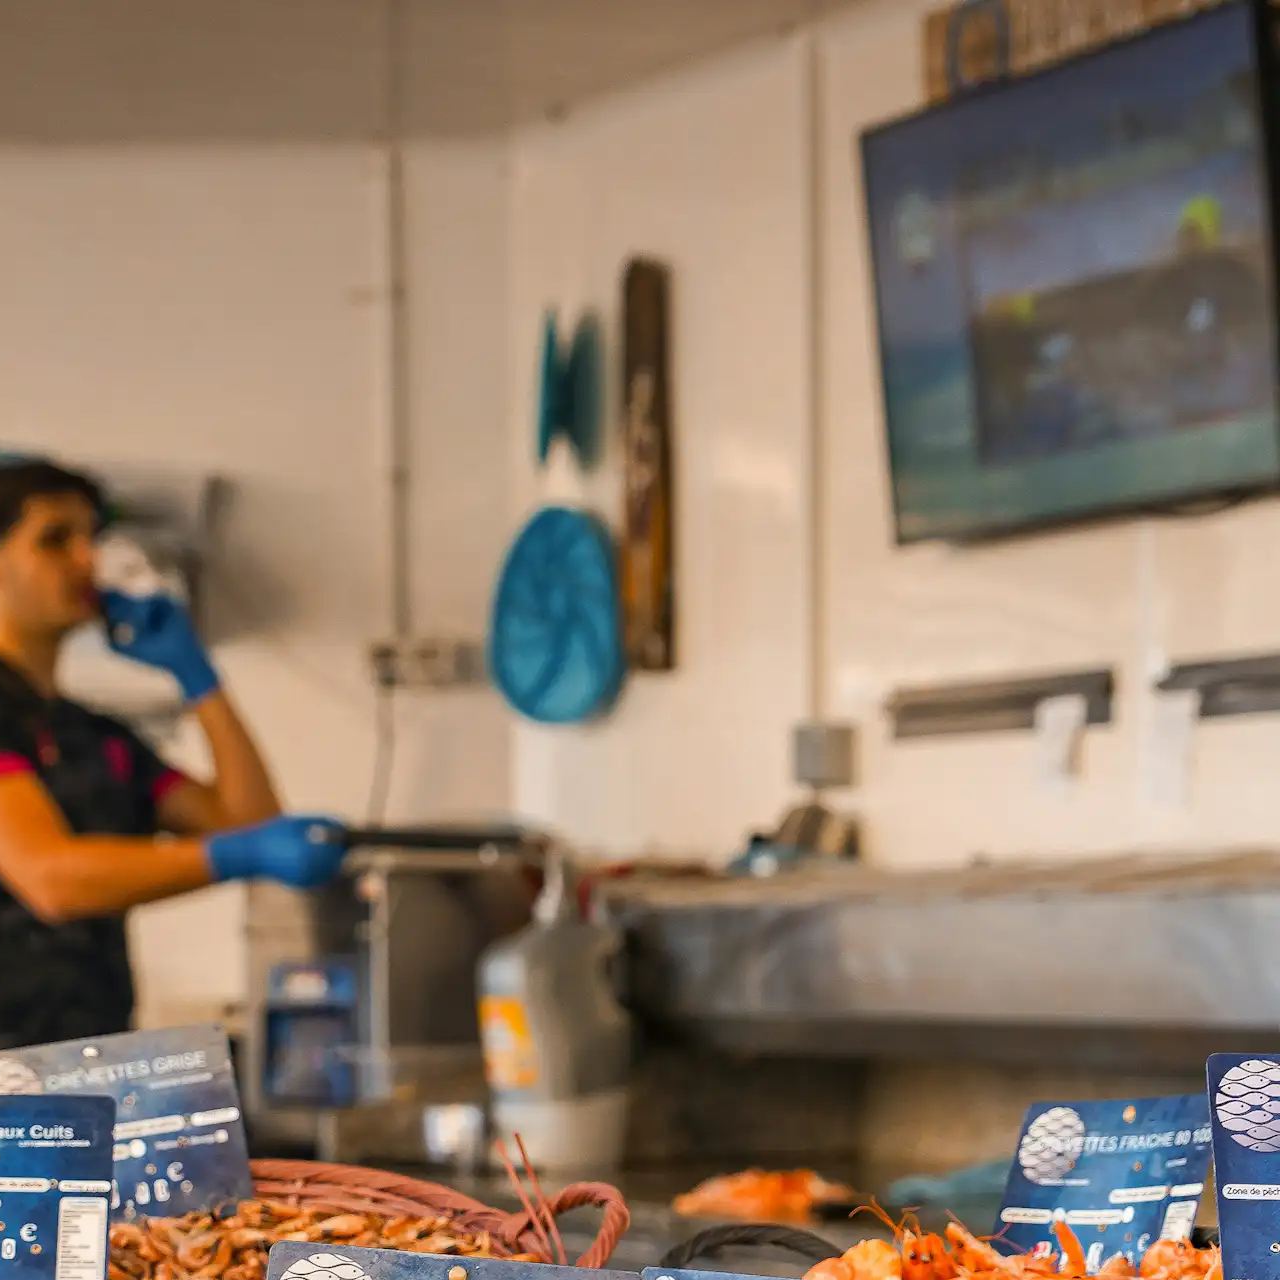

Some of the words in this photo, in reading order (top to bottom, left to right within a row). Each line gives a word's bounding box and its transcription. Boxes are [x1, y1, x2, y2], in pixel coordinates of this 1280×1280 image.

[29, 1124, 75, 1140] Cuits
[1227, 1186, 1247, 1195] Zone
[1250, 1187, 1260, 1195] de
